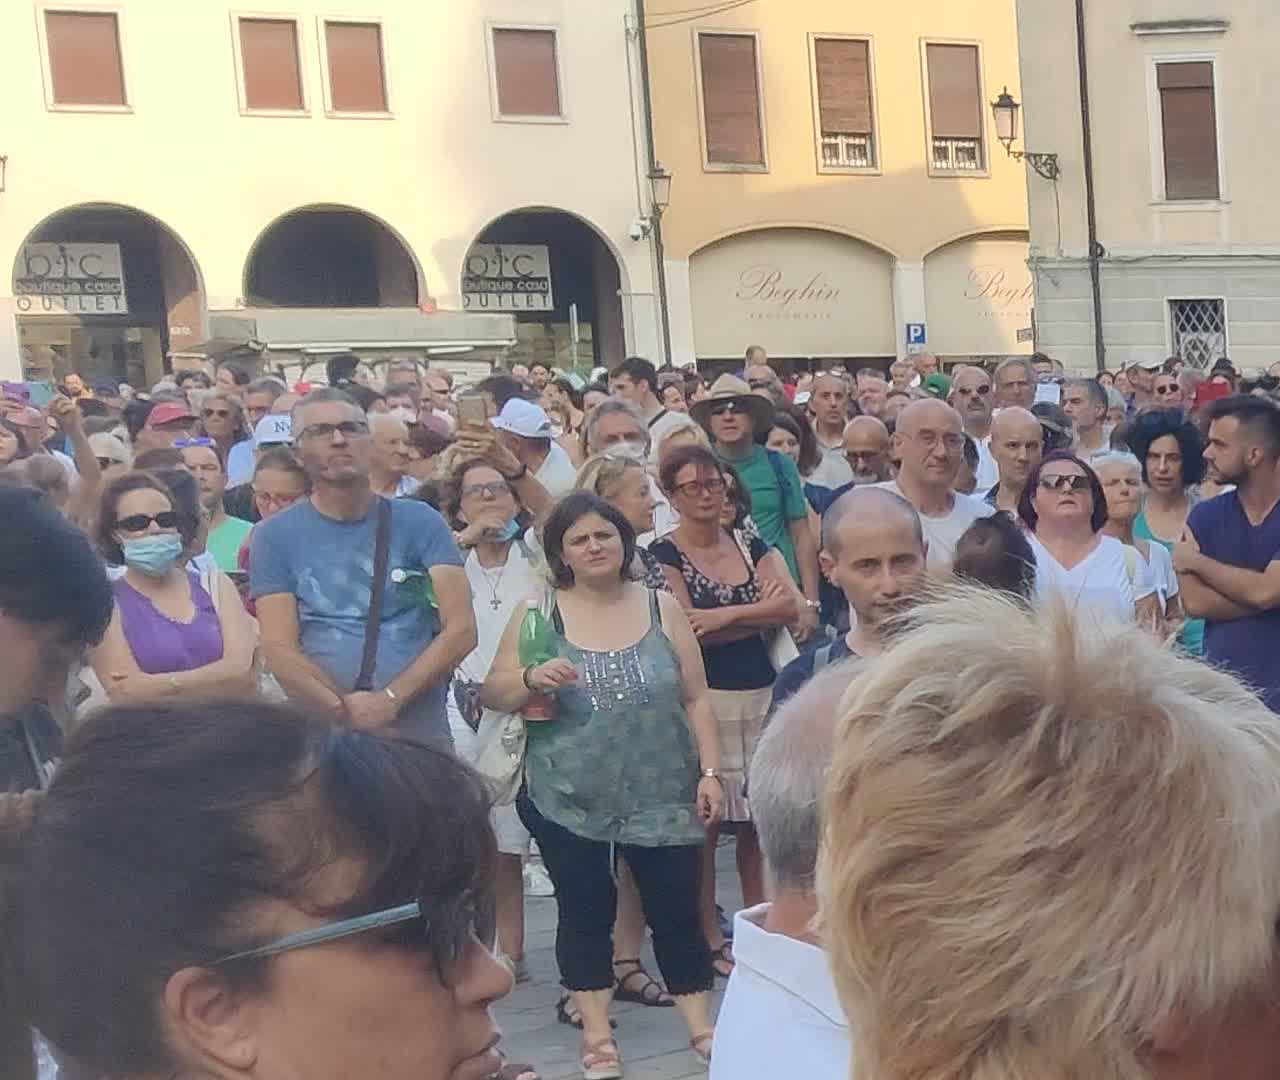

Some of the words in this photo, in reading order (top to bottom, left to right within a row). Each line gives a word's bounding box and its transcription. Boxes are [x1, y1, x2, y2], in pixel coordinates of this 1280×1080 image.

[735, 263, 840, 308] Beghin
[17, 295, 120, 311] OUTLET
[909, 325, 922, 341] P
